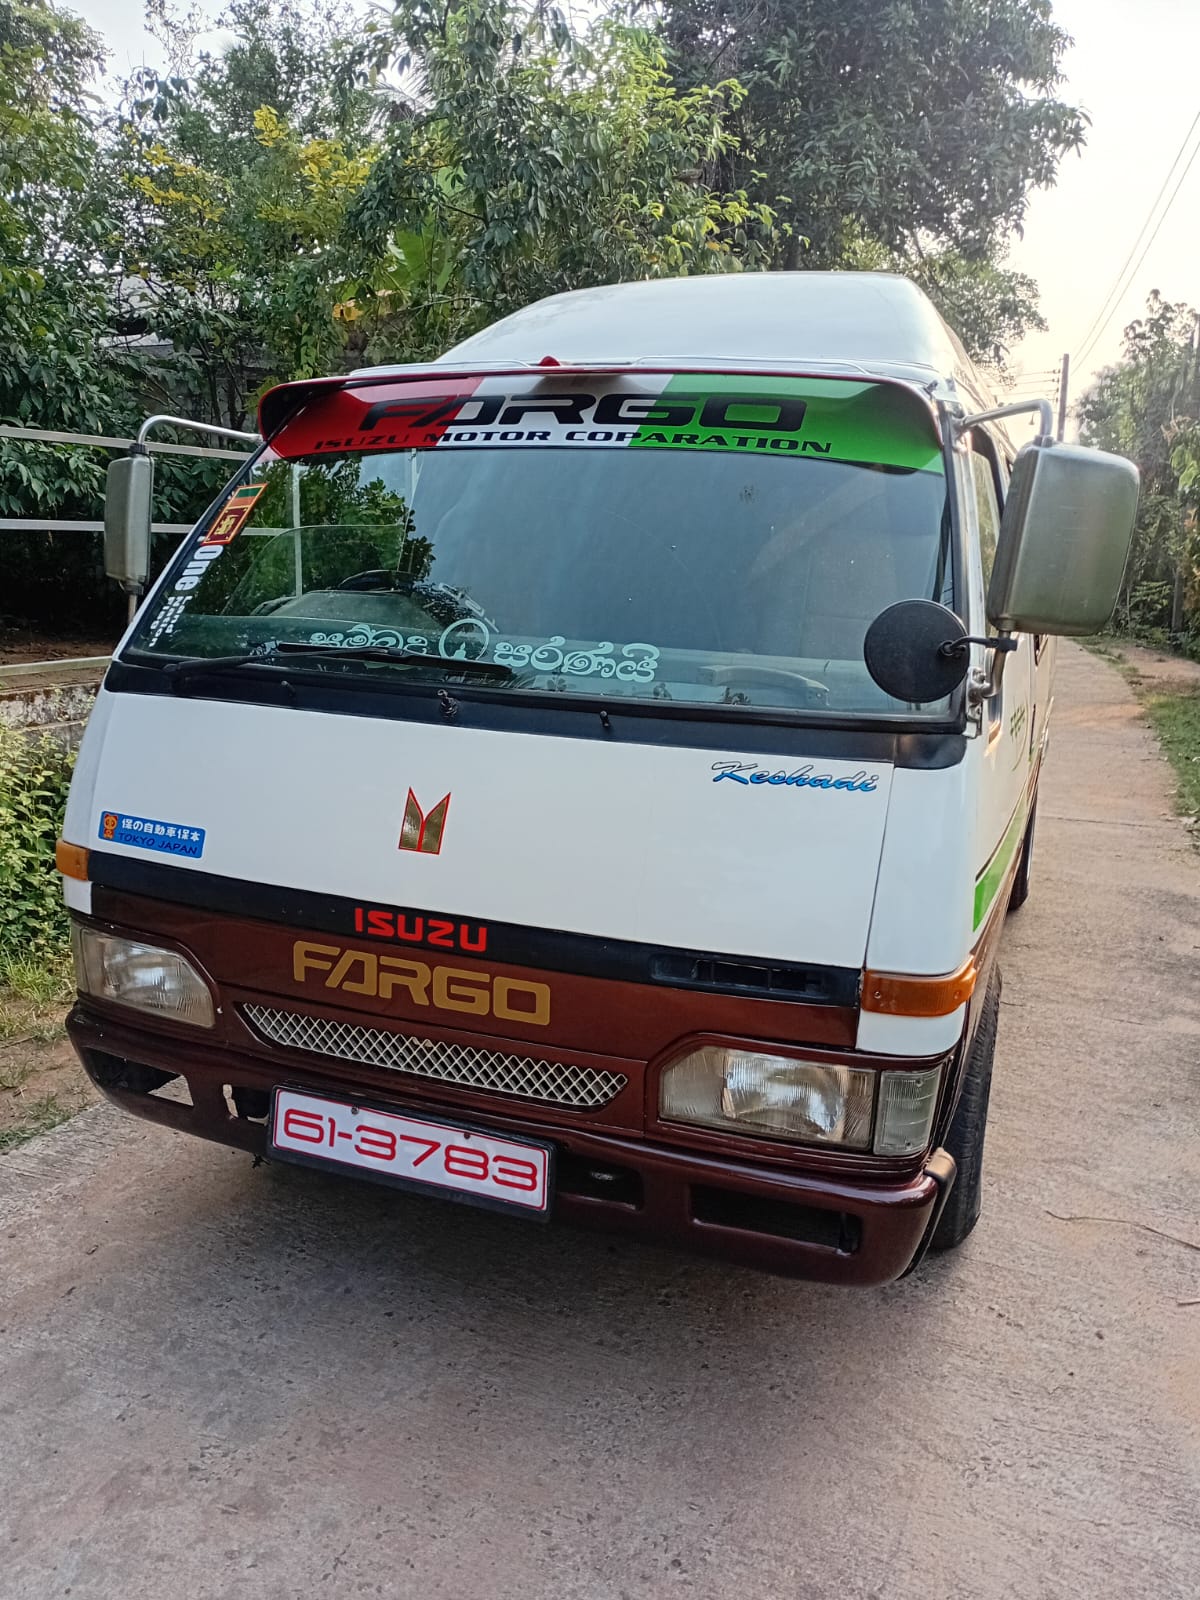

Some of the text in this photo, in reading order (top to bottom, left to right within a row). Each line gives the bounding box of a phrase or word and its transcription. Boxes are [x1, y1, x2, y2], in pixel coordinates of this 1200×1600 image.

[359, 393, 807, 432] FARGO
[314, 430, 832, 453] ISUZU MOTOR COPARATION
[711, 761, 880, 792] Keshadi
[119, 832, 198, 855] TOKYO JAPAN
[354, 907, 487, 952] ISUZU
[293, 940, 550, 1026] FARGO
[284, 1108, 538, 1192] 61-3783
